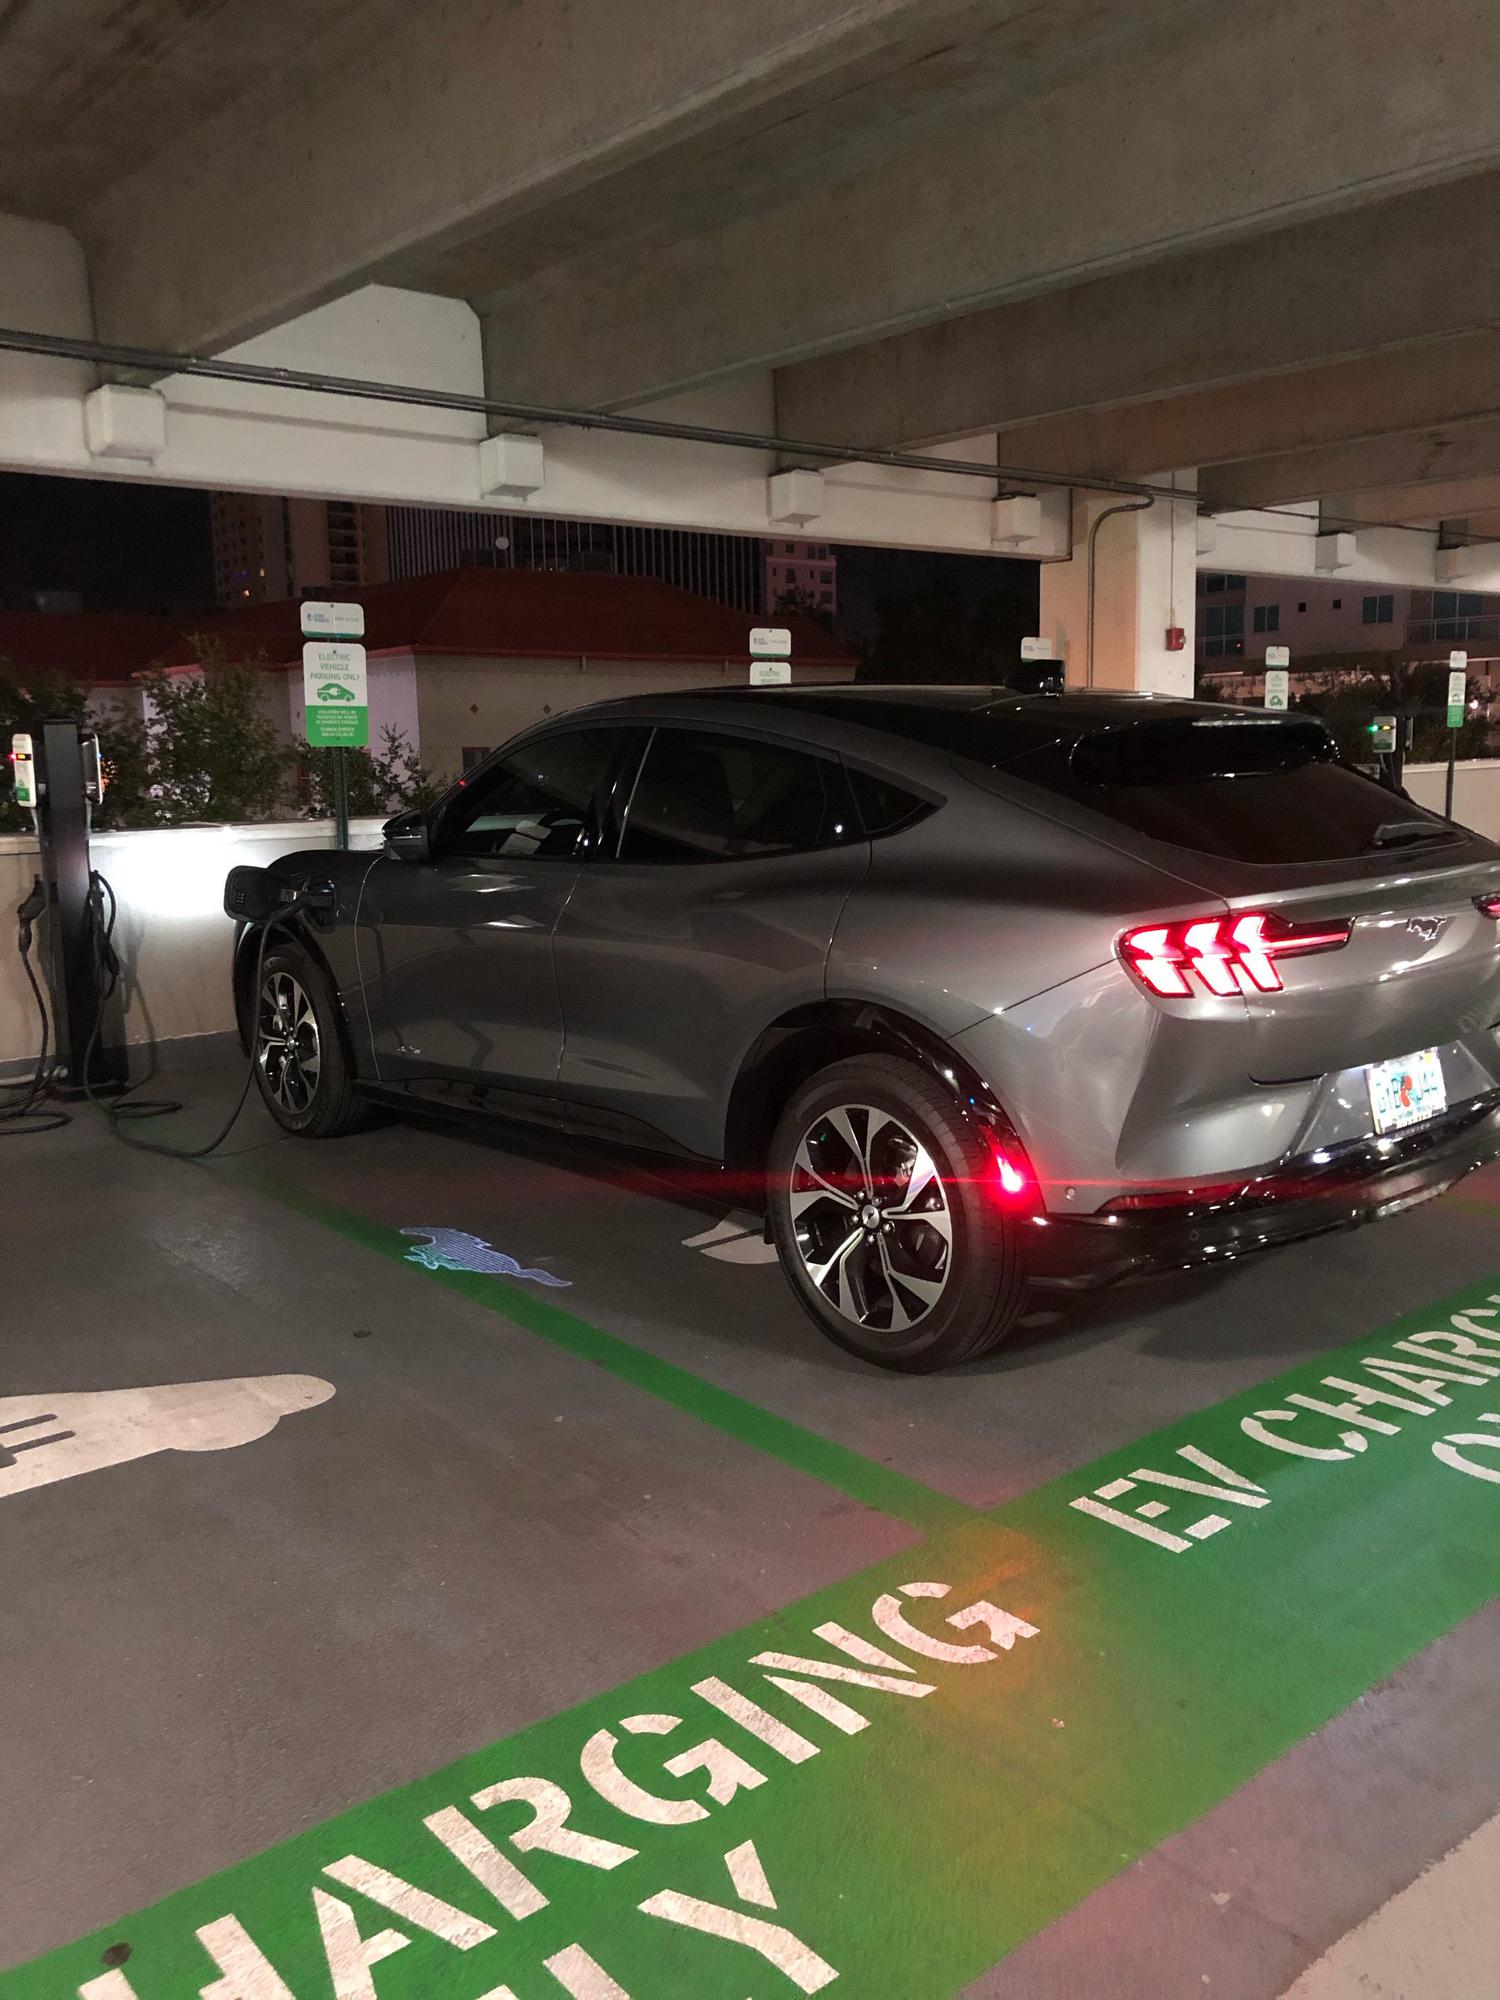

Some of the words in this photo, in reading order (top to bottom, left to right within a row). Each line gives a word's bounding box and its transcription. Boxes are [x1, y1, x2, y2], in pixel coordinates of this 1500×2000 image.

[318, 653, 351, 662] ELECTRIC
[320, 663, 349, 671] VEHICLE
[310, 672, 341, 681] PARKING
[343, 672, 360, 681] ONLY
[1069, 1444, 1272, 1553] EV
[1241, 1294, 1500, 1461] CHAR
